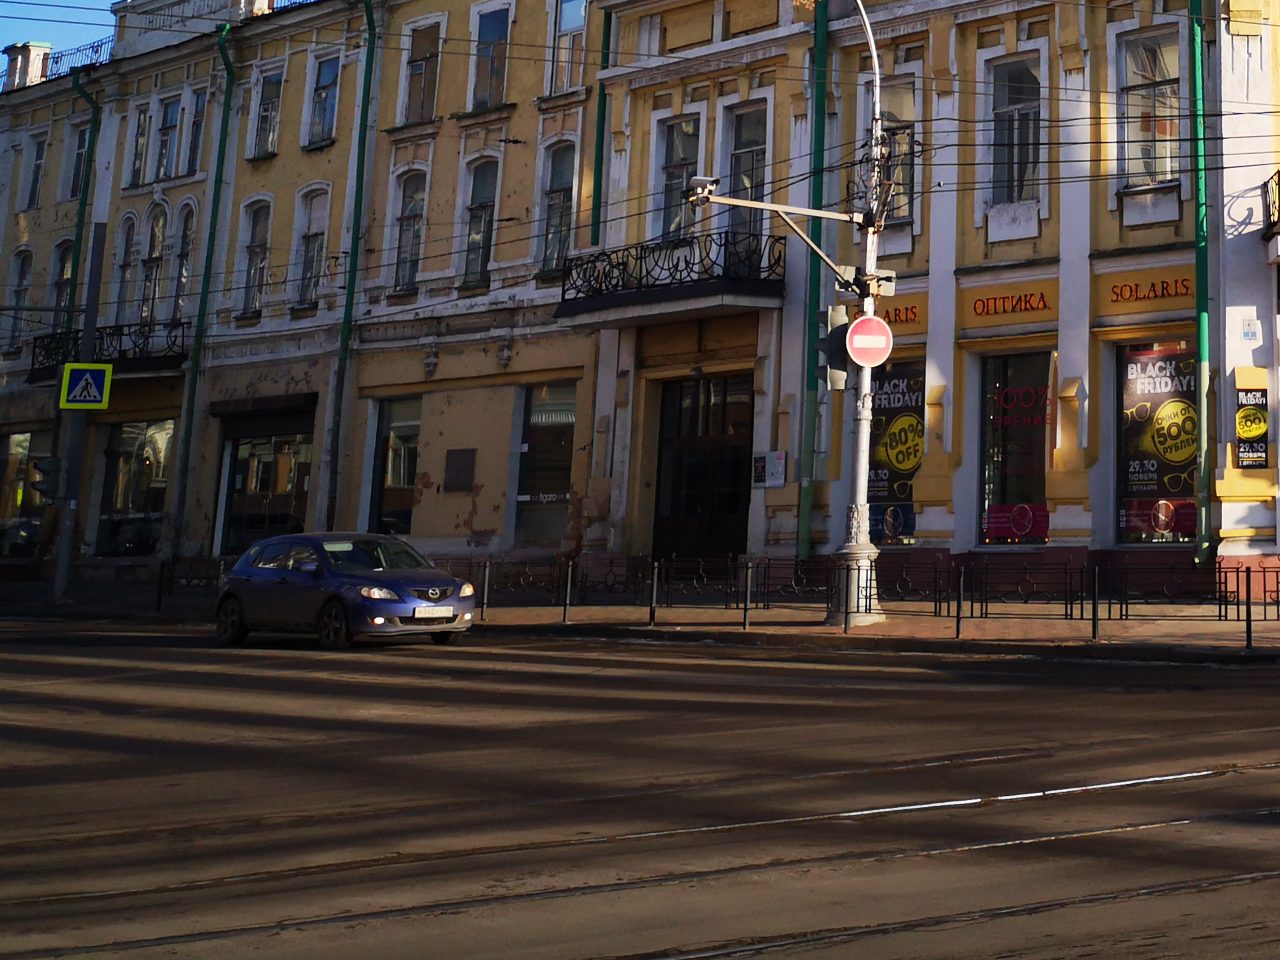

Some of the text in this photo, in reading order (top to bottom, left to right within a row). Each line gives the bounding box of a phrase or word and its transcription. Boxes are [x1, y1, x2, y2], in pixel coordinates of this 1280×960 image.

[1110, 278, 1190, 302] SOLARIS
[973, 292, 1048, 316] ОПТИКА
[1127, 361, 1176, 380] BLACK
[1136, 375, 1195, 394] FRIDAY!
[874, 392, 923, 409] FRIDAY!
[1155, 416, 1197, 446] 500
[895, 442, 920, 464] OFF
